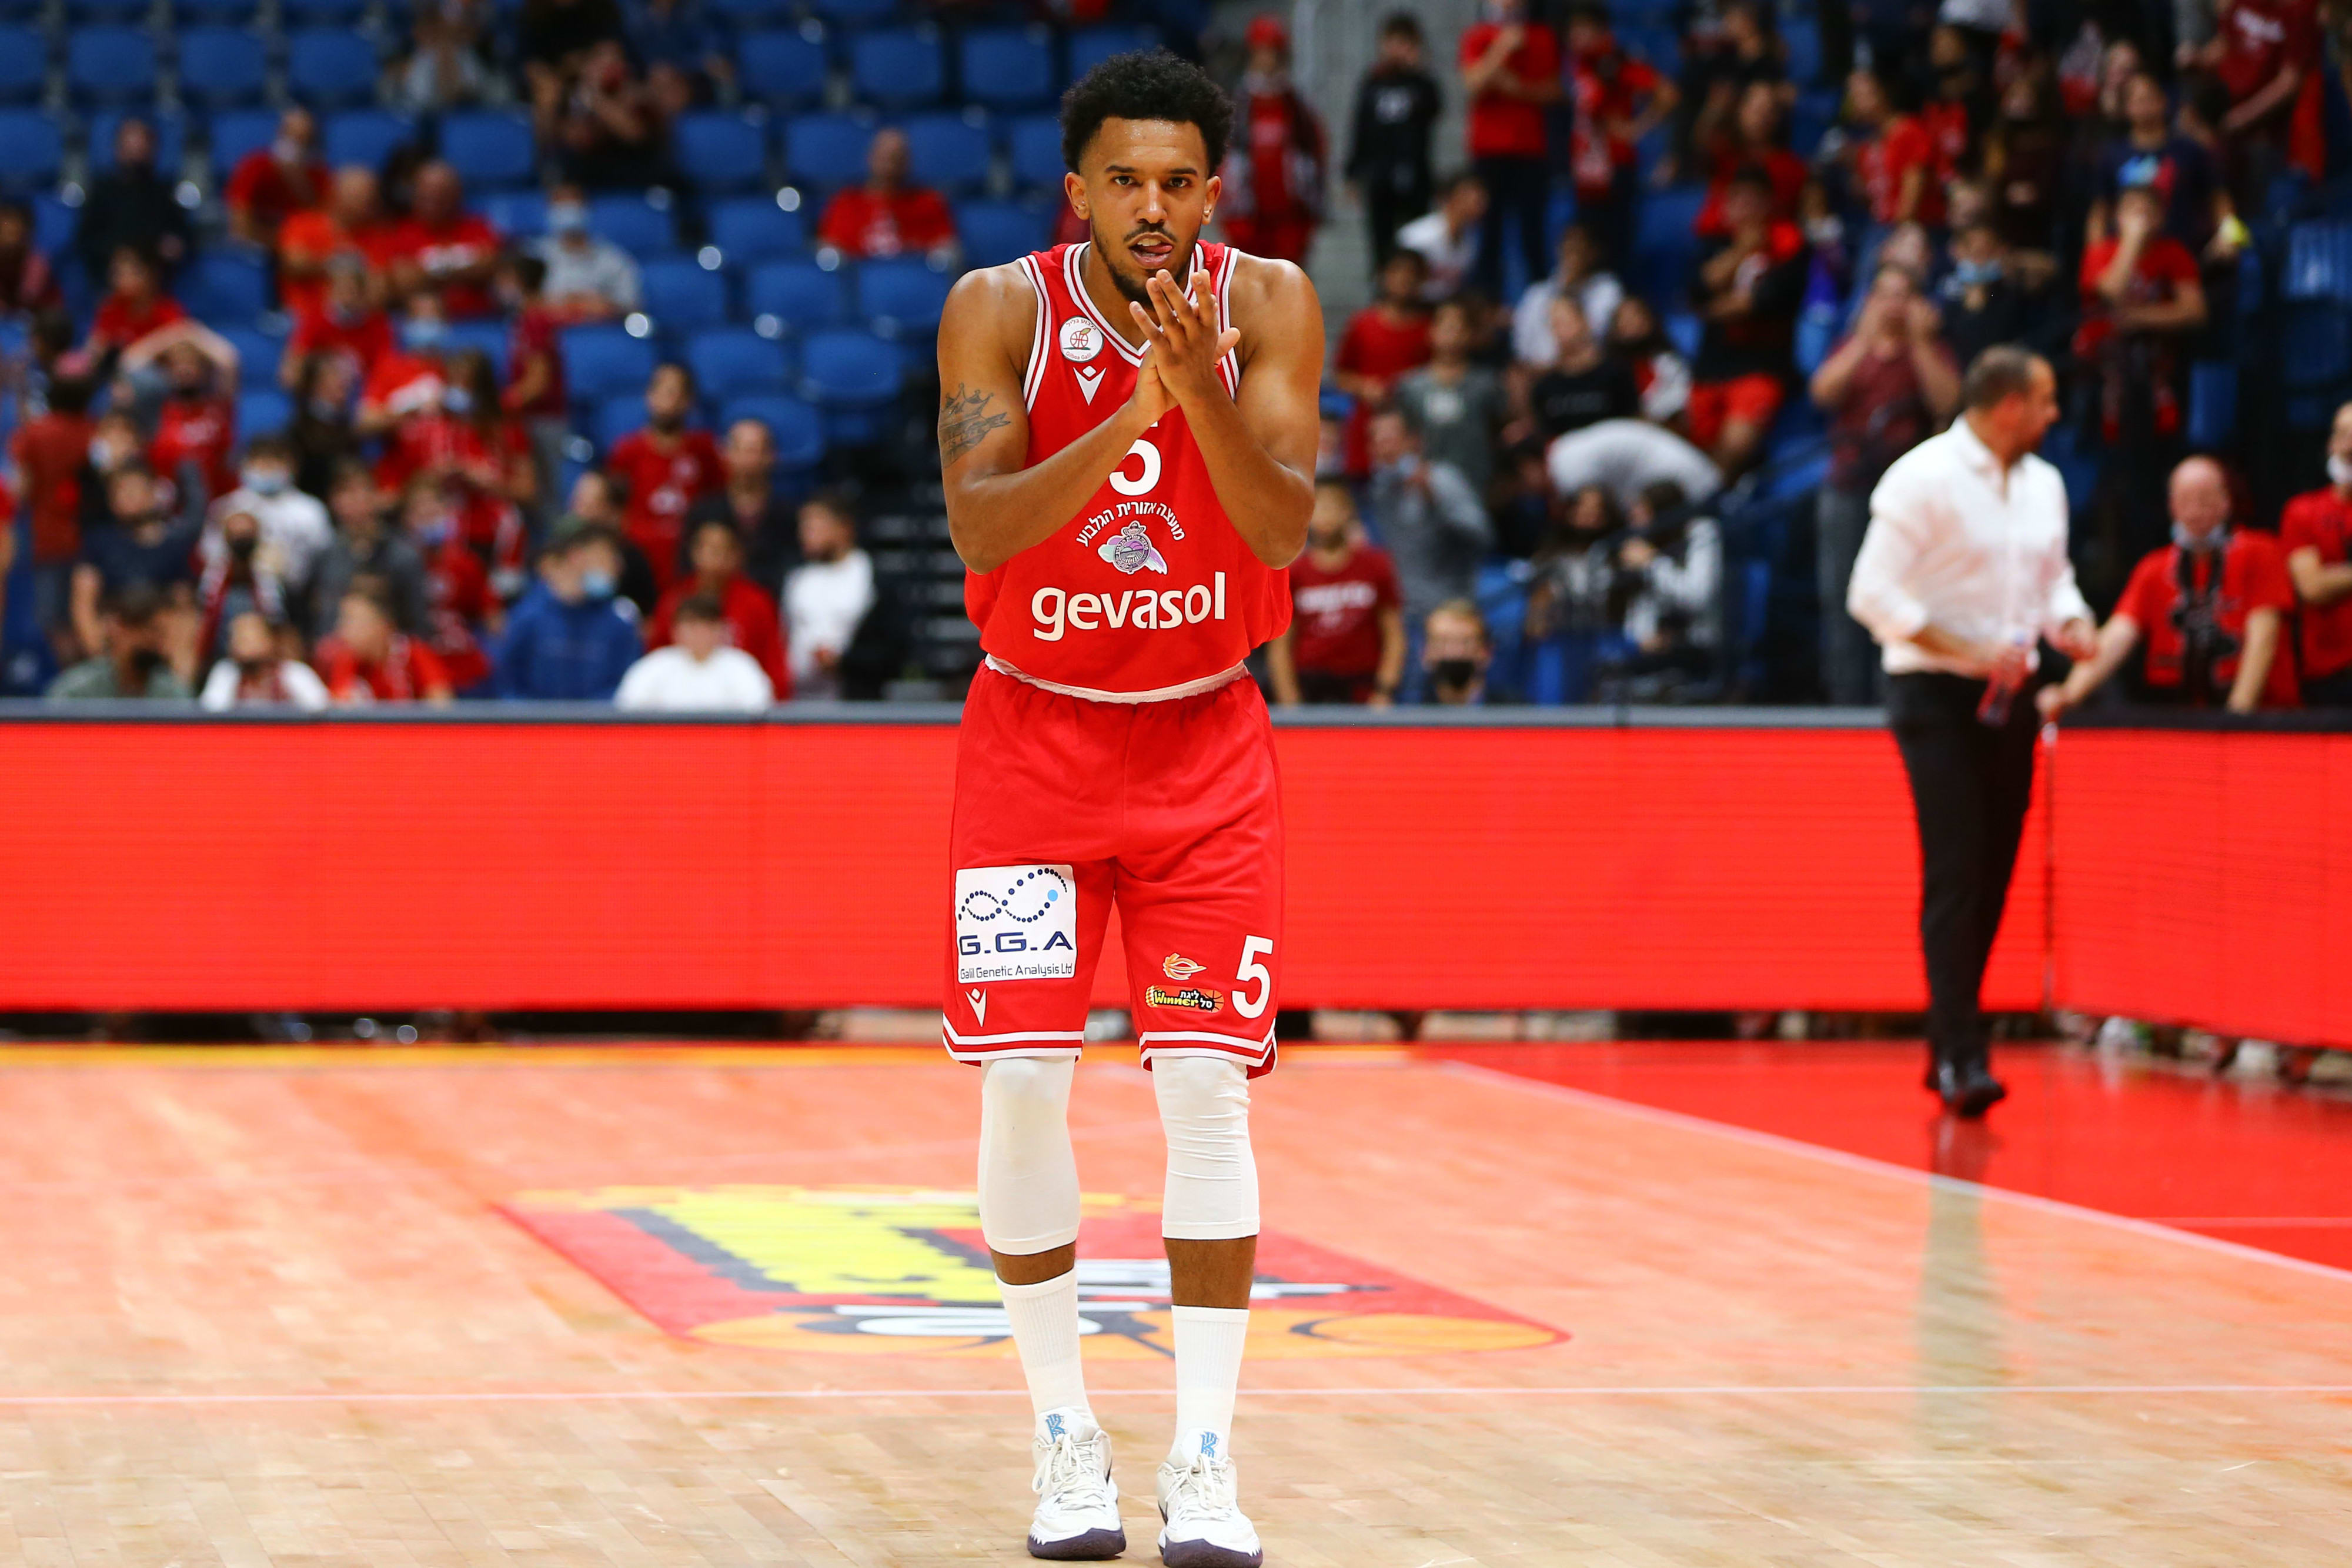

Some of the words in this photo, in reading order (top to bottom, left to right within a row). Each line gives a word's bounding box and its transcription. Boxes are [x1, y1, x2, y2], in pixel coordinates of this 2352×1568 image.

[1115, 502, 1157, 517] אזורית
[1075, 509, 1115, 547] הגלבוע
[1155, 503, 1185, 540] מועצה
[1031, 571, 1225, 641] gevasol
[959, 931, 1074, 956] G.G.A
[960, 967, 975, 979] Galil
[975, 965, 1013, 978] Genetic
[1015, 963, 1060, 977] Analysis
[1061, 962, 1073, 974] Ltd
[1232, 934, 1274, 1019] 5
[1154, 991, 1199, 1007] Winner
[1180, 990, 1200, 999] ליגת
[1200, 997, 1212, 1008] סל
